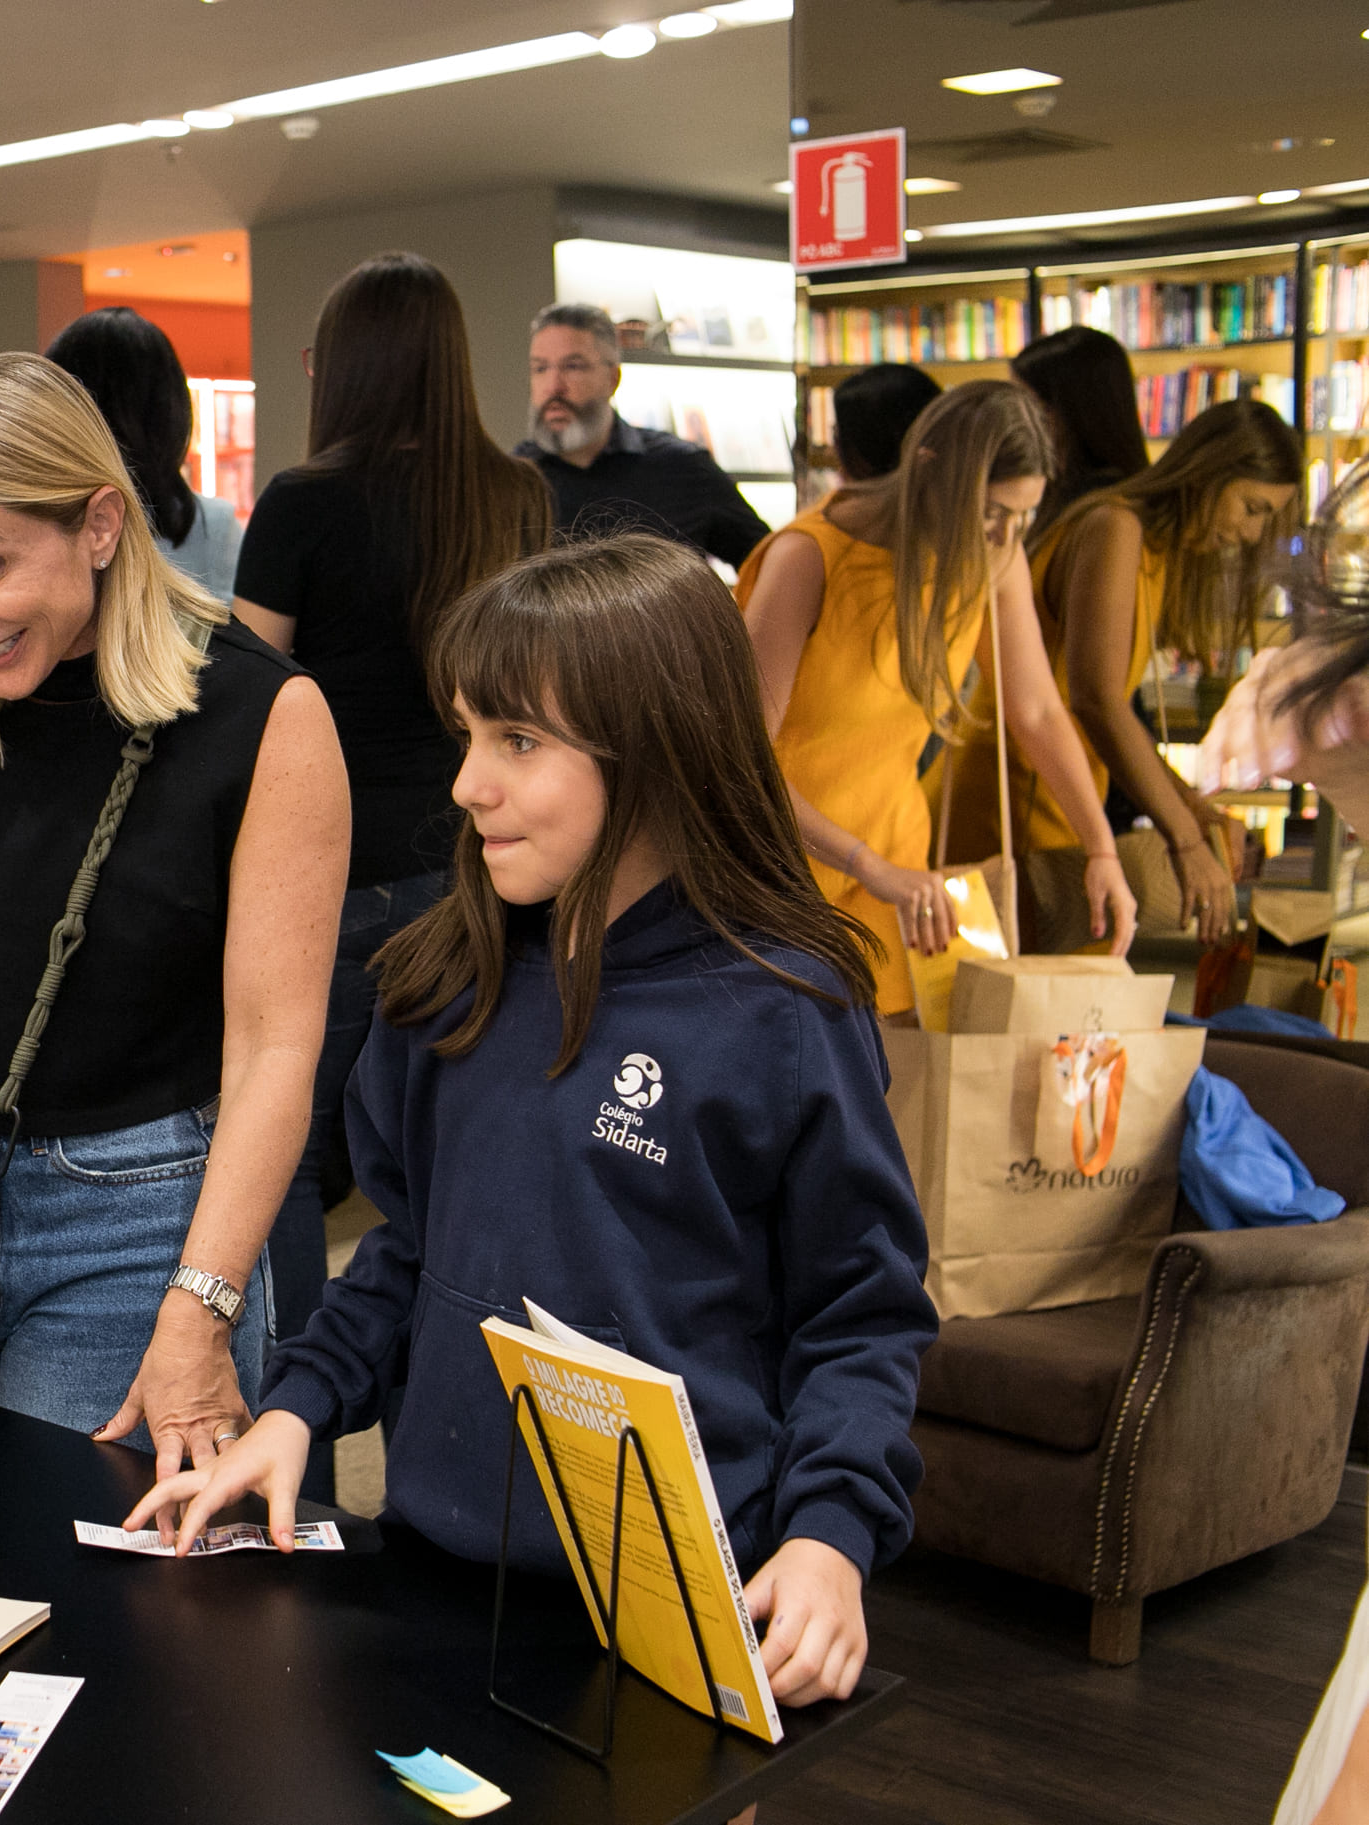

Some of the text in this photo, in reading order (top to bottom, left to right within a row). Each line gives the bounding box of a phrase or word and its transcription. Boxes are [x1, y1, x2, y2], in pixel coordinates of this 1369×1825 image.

[599, 1101, 644, 1127] Colégio
[591, 1116, 668, 1166] Sidarta
[523, 1353, 627, 1409] O MILAGRE DO
[713, 1518, 721, 1528] O
[717, 1529, 736, 1577] MILAGRE
